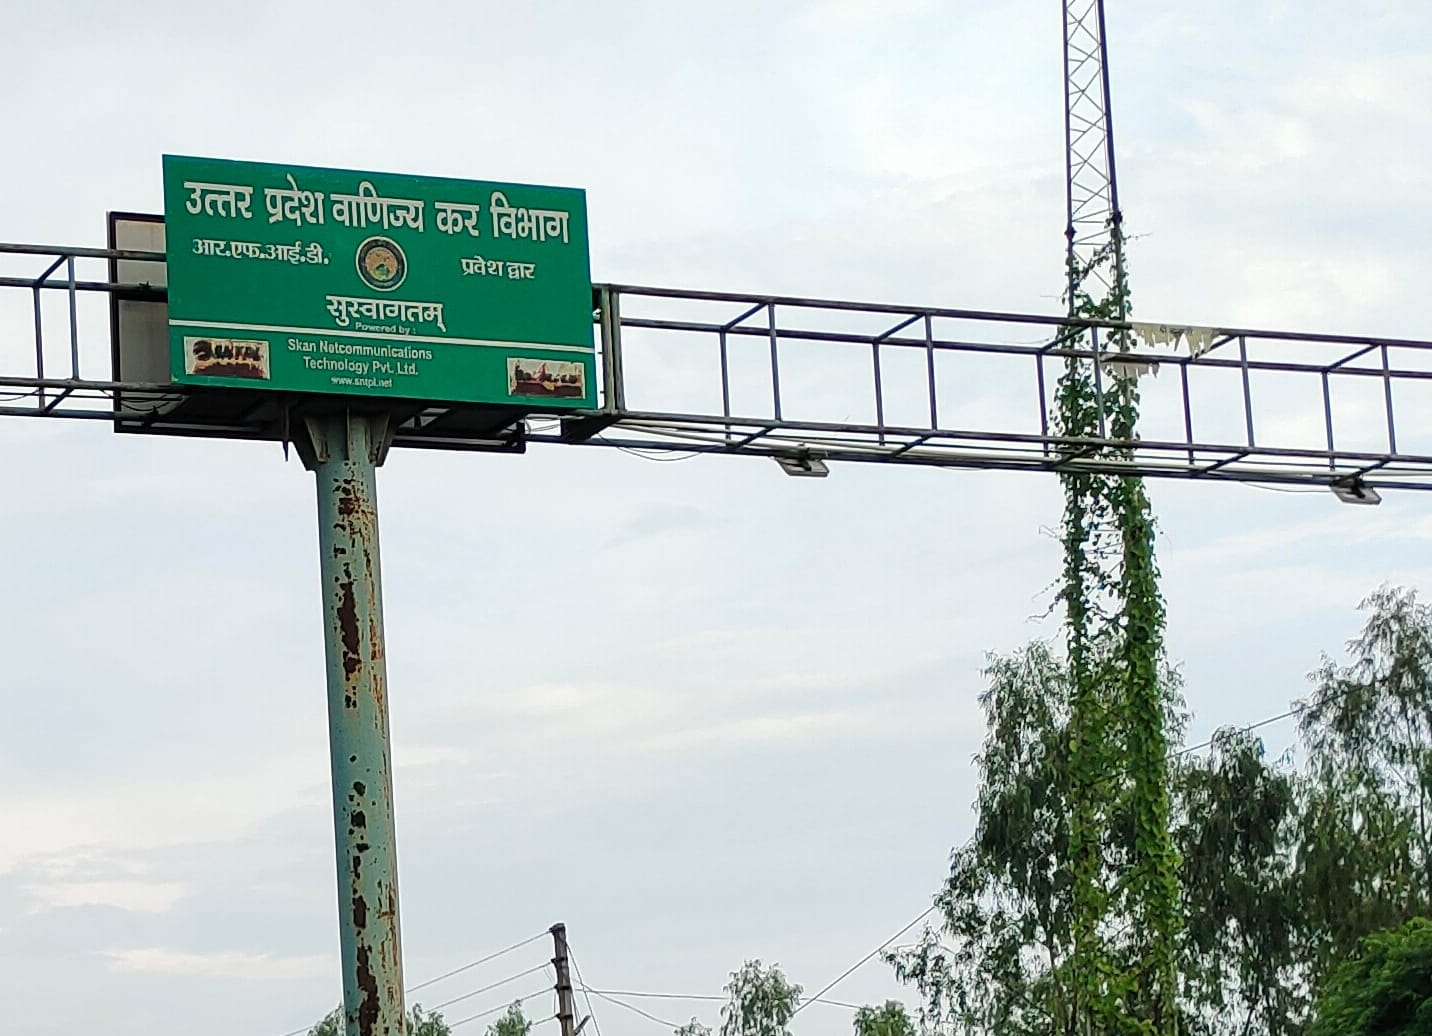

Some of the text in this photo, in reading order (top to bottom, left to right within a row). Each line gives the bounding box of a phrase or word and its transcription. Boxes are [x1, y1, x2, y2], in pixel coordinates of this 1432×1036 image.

[183, 172, 569, 244] उत्तर प्रदेश वाणिज्य कर विभाग
[460, 255, 504, 277] प्रवेश
[505, 261, 536, 280] द्वार
[325, 295, 447, 333] सुस्वागतम्
[355, 321, 396, 334] Powered
[287, 338, 317, 352] Skan
[303, 356, 369, 376] Technology
[396, 362, 419, 376] Ltd.
